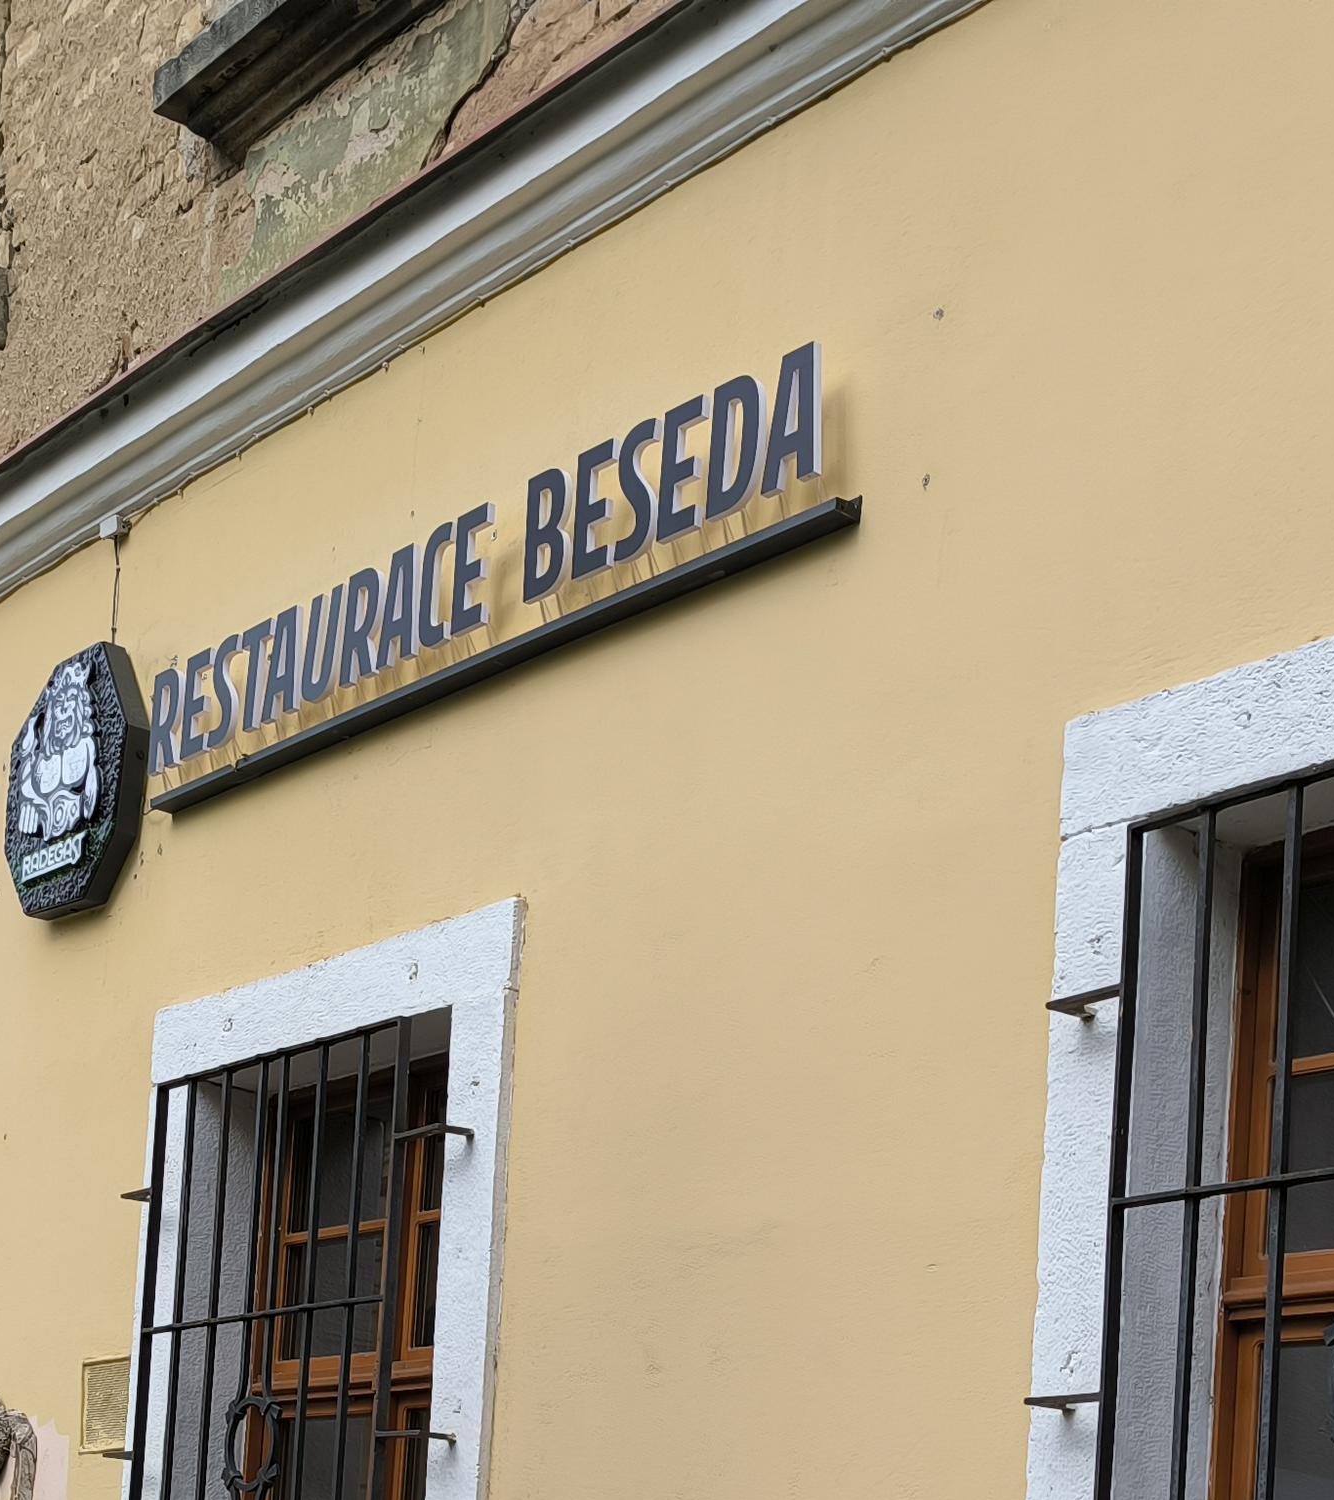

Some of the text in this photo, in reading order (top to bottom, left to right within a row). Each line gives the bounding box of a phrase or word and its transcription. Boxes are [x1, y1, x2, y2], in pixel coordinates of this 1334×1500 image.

[149, 341, 822, 776] RESTAURACE BESEDA
[21, 830, 87, 879] RADEGAST
